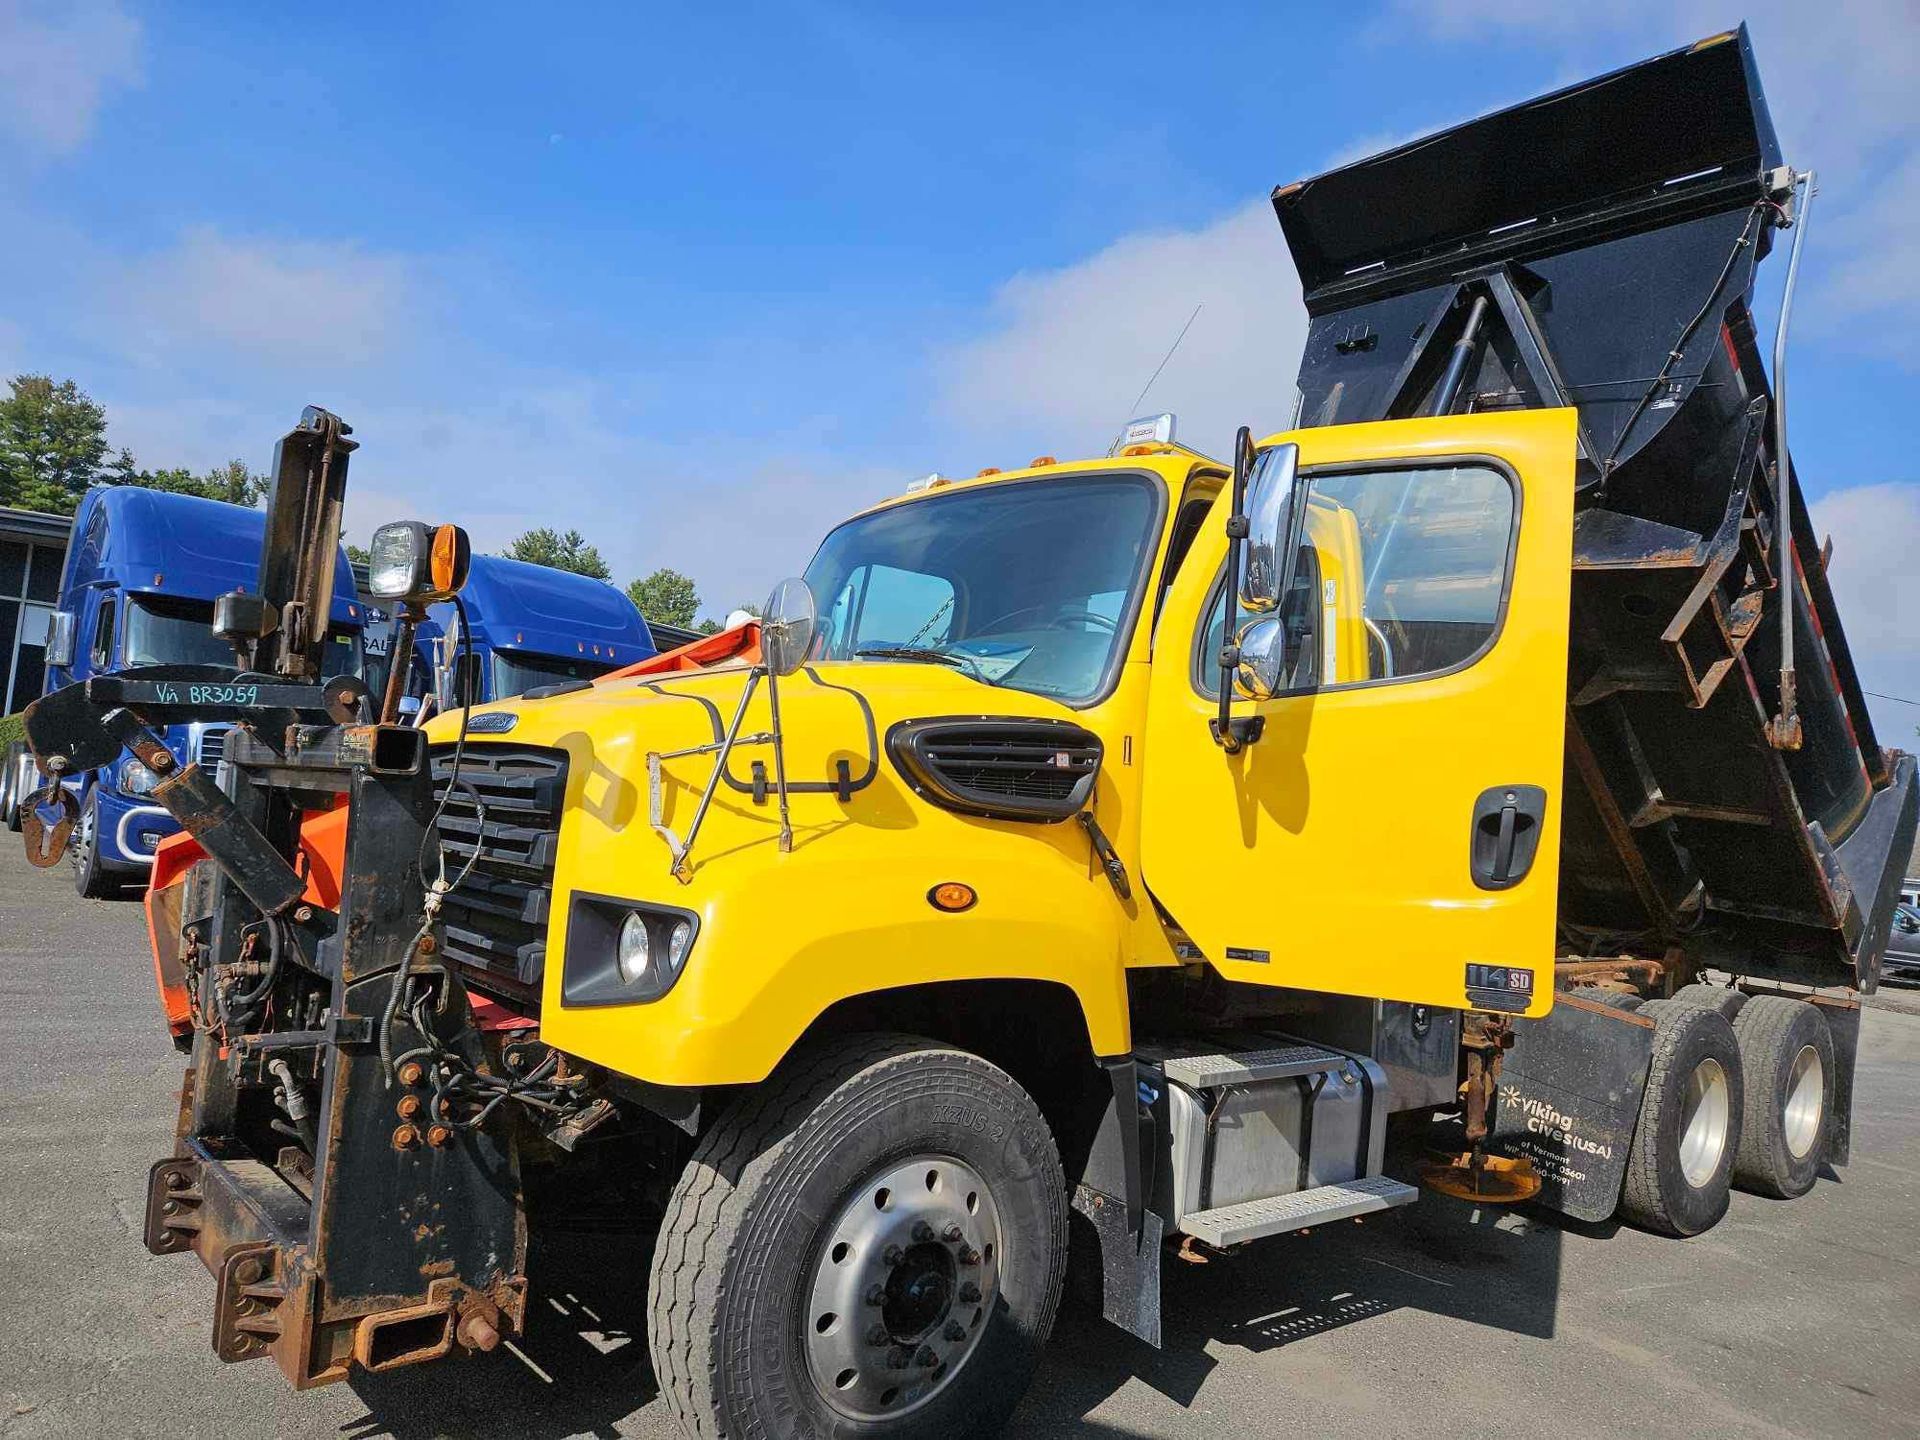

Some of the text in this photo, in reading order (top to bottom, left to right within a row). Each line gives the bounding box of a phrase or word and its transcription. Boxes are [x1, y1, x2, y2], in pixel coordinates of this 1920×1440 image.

[1468, 965, 1529, 990] 114 SD
[1522, 1097, 1572, 1131] Viking
[1521, 1141, 1570, 1165] of Vermont
